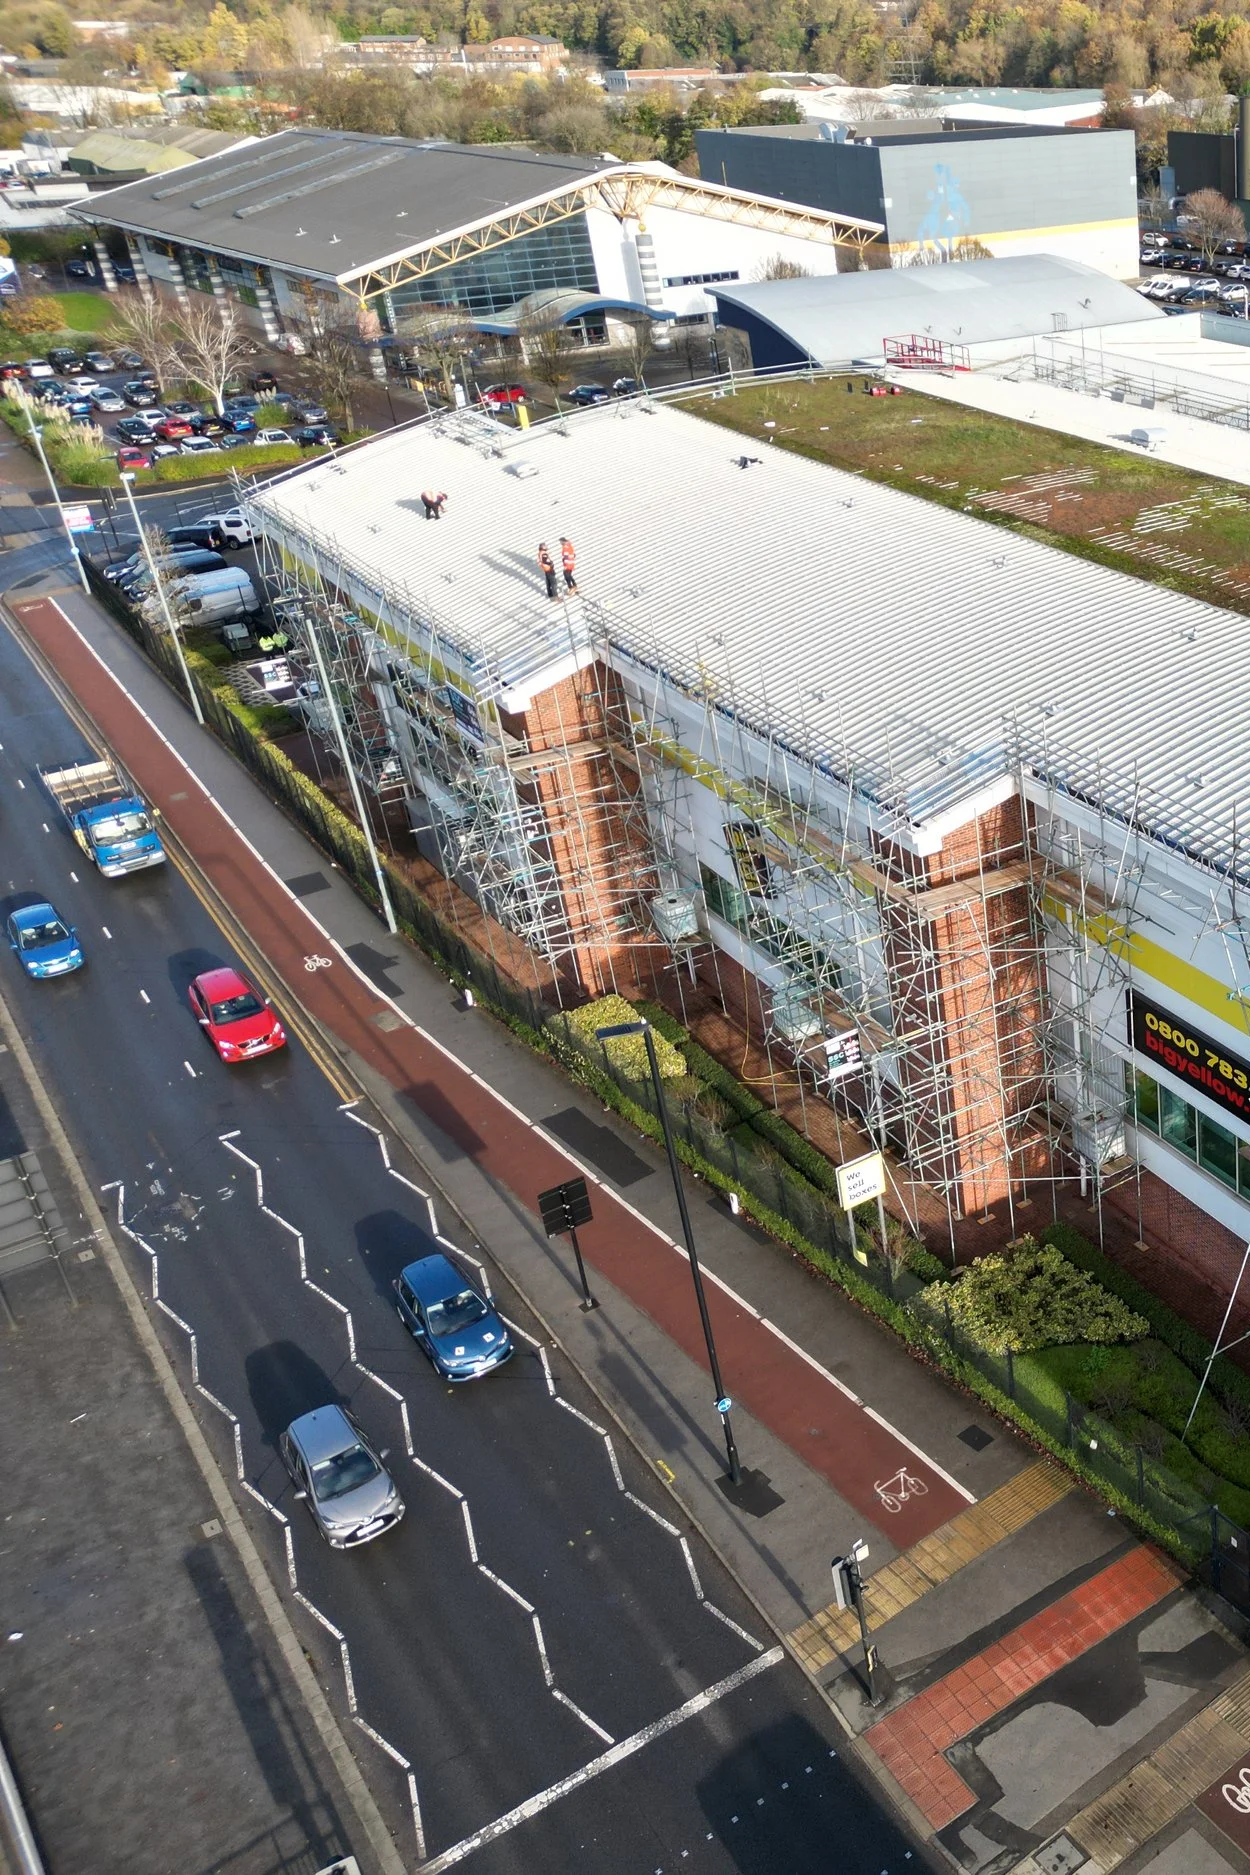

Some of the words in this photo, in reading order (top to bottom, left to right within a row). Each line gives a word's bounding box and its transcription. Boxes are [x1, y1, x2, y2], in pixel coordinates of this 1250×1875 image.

[1144, 1012, 1200, 1057] 0800
[1205, 1049, 1248, 1089] 783
[846, 1171, 861, 1181] We
[847, 1178, 865, 1191] sell
